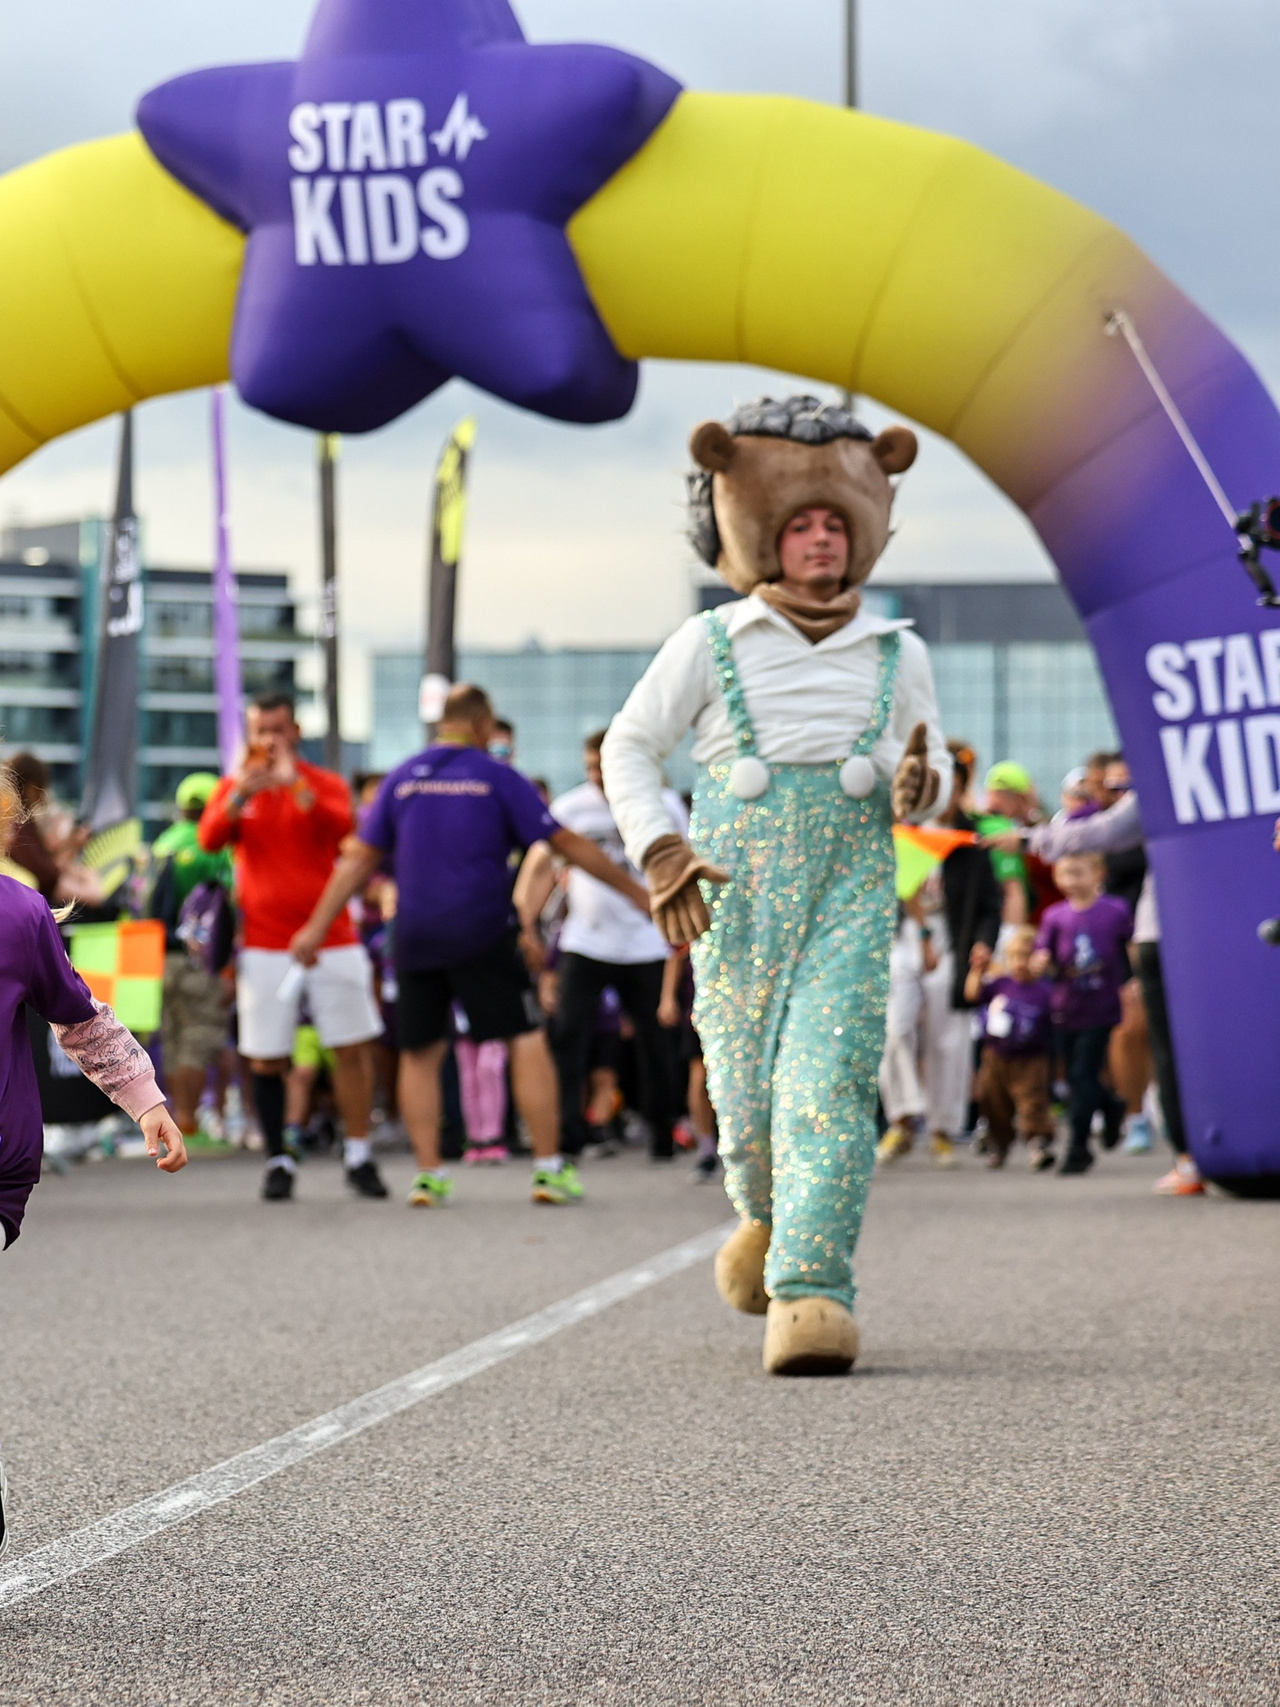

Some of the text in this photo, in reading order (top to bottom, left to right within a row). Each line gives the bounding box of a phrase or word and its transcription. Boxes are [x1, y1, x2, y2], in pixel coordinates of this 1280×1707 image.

[288, 98, 427, 172] STAR
[290, 167, 469, 266] KIDS
[1159, 713, 1280, 824] KID
